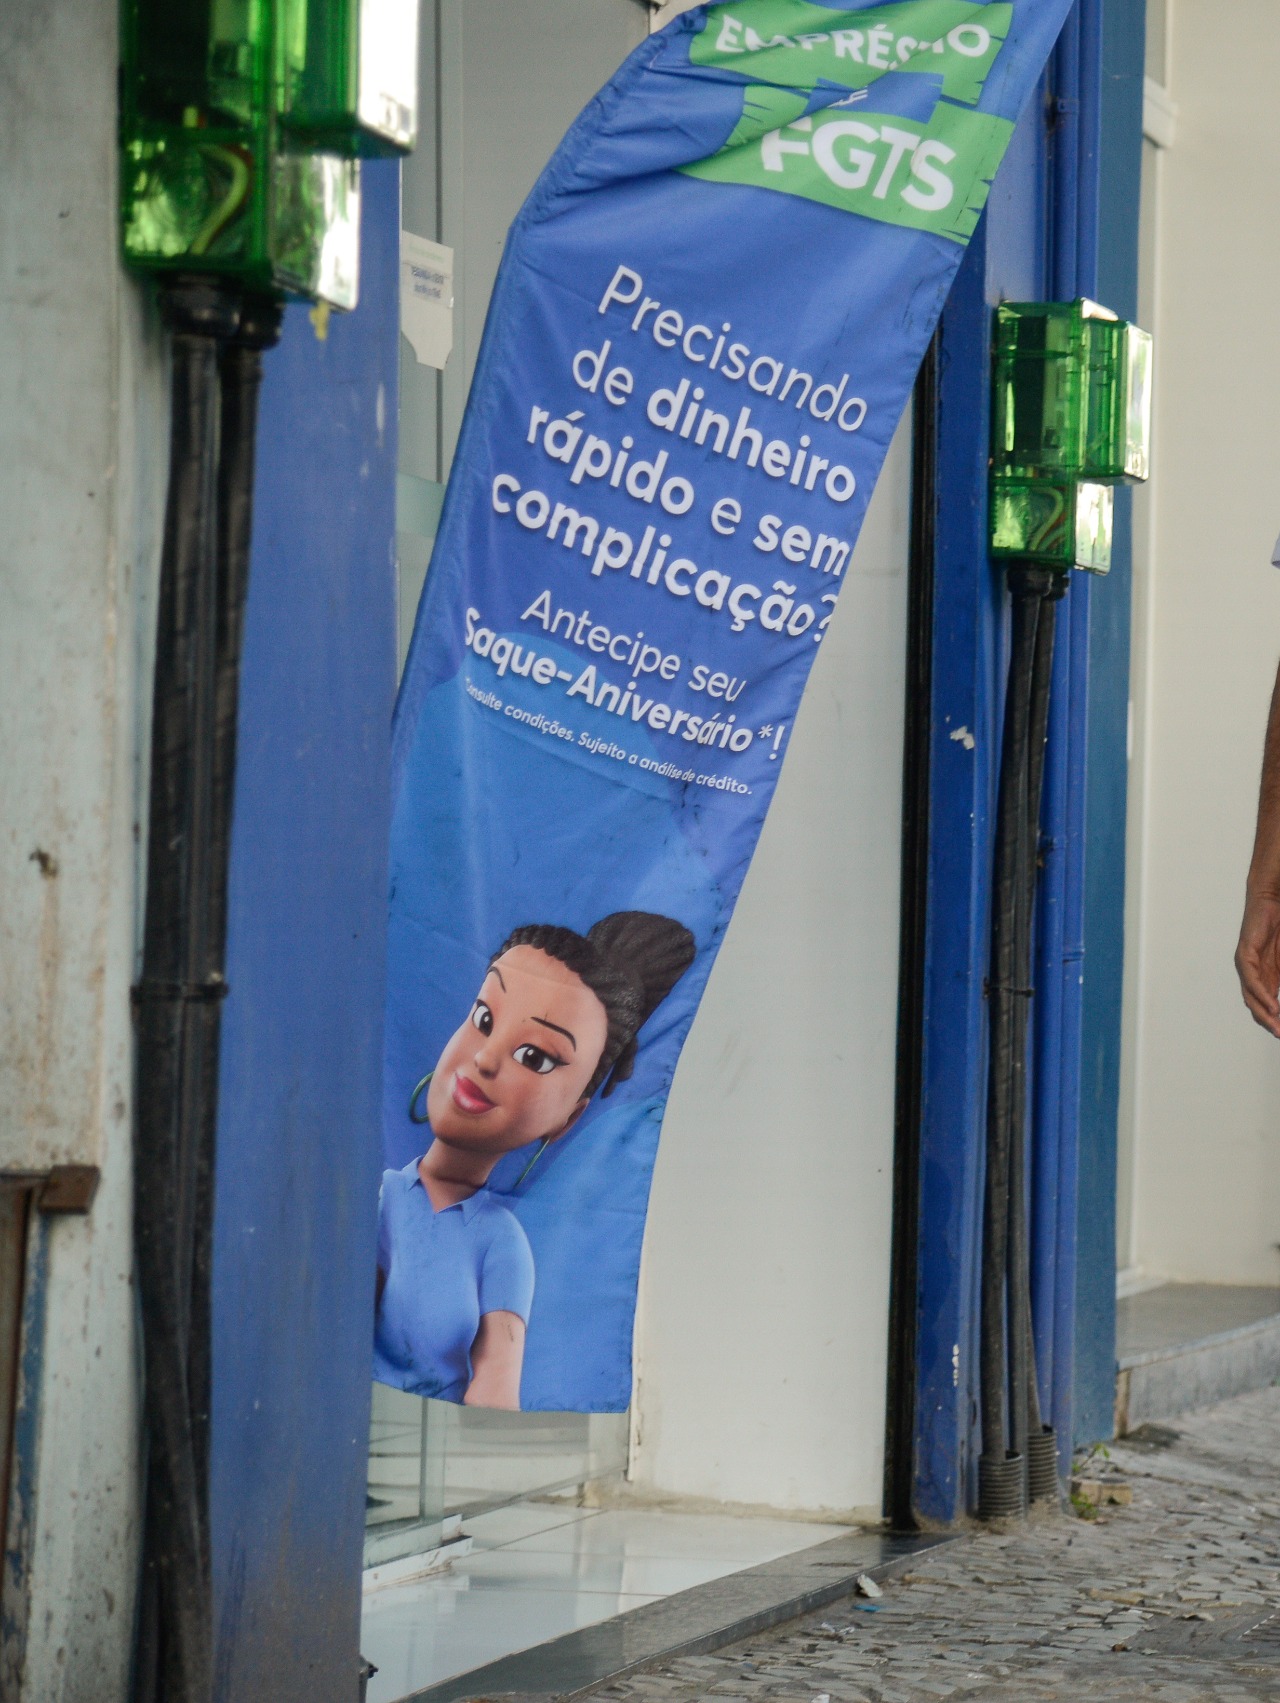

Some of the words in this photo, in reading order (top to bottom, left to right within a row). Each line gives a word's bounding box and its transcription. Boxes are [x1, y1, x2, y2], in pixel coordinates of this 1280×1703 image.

[715, 14, 990, 70] EMPRÉSO
[761, 116, 957, 212] FGTS
[598, 264, 868, 432] Precisando
[572, 340, 634, 406] de
[646, 378, 856, 502] dinheiro
[491, 473, 838, 642] complicação?
[526, 405, 695, 515] rápido
[710, 497, 742, 535] e
[752, 513, 850, 576] sem
[520, 589, 681, 680] Antecipe
[687, 664, 747, 702] seu
[503, 703, 575, 742] condições.
[577, 732, 627, 761] Sujeito
[628, 753, 639, 765] a
[639, 758, 682, 779] análise
[681, 768, 696, 782] de
[695, 774, 753, 795] crédito.
